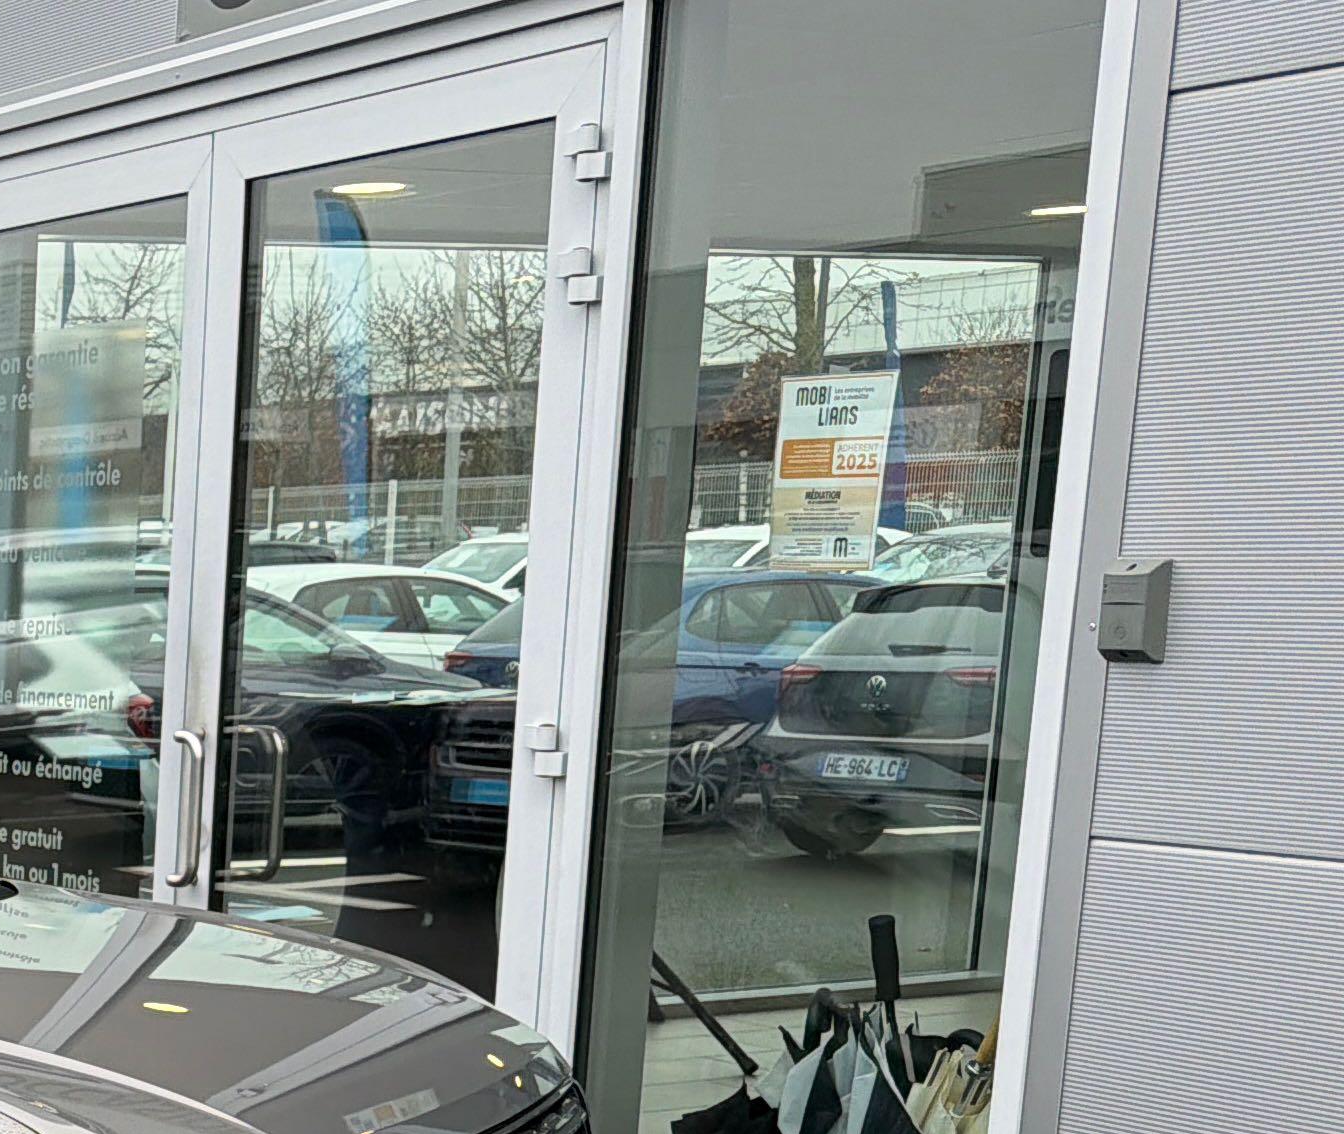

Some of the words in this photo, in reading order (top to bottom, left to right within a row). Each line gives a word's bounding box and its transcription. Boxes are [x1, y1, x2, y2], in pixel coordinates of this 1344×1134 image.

[796, 386, 832, 406] MOBI
[818, 405, 859, 426] LIANS
[58, 459, 121, 488] contrôle
[836, 453, 879, 470] 2025
[16, 681, 115, 711] financement
[12, 759, 31, 777] ou
[35, 755, 103, 788] échangé
[11, 826, 64, 851] gratuit
[3, 854, 25, 881] km
[29, 866, 48, 884] ou
[52, 862, 59, 887] 1
[63, 868, 101, 893] mois
